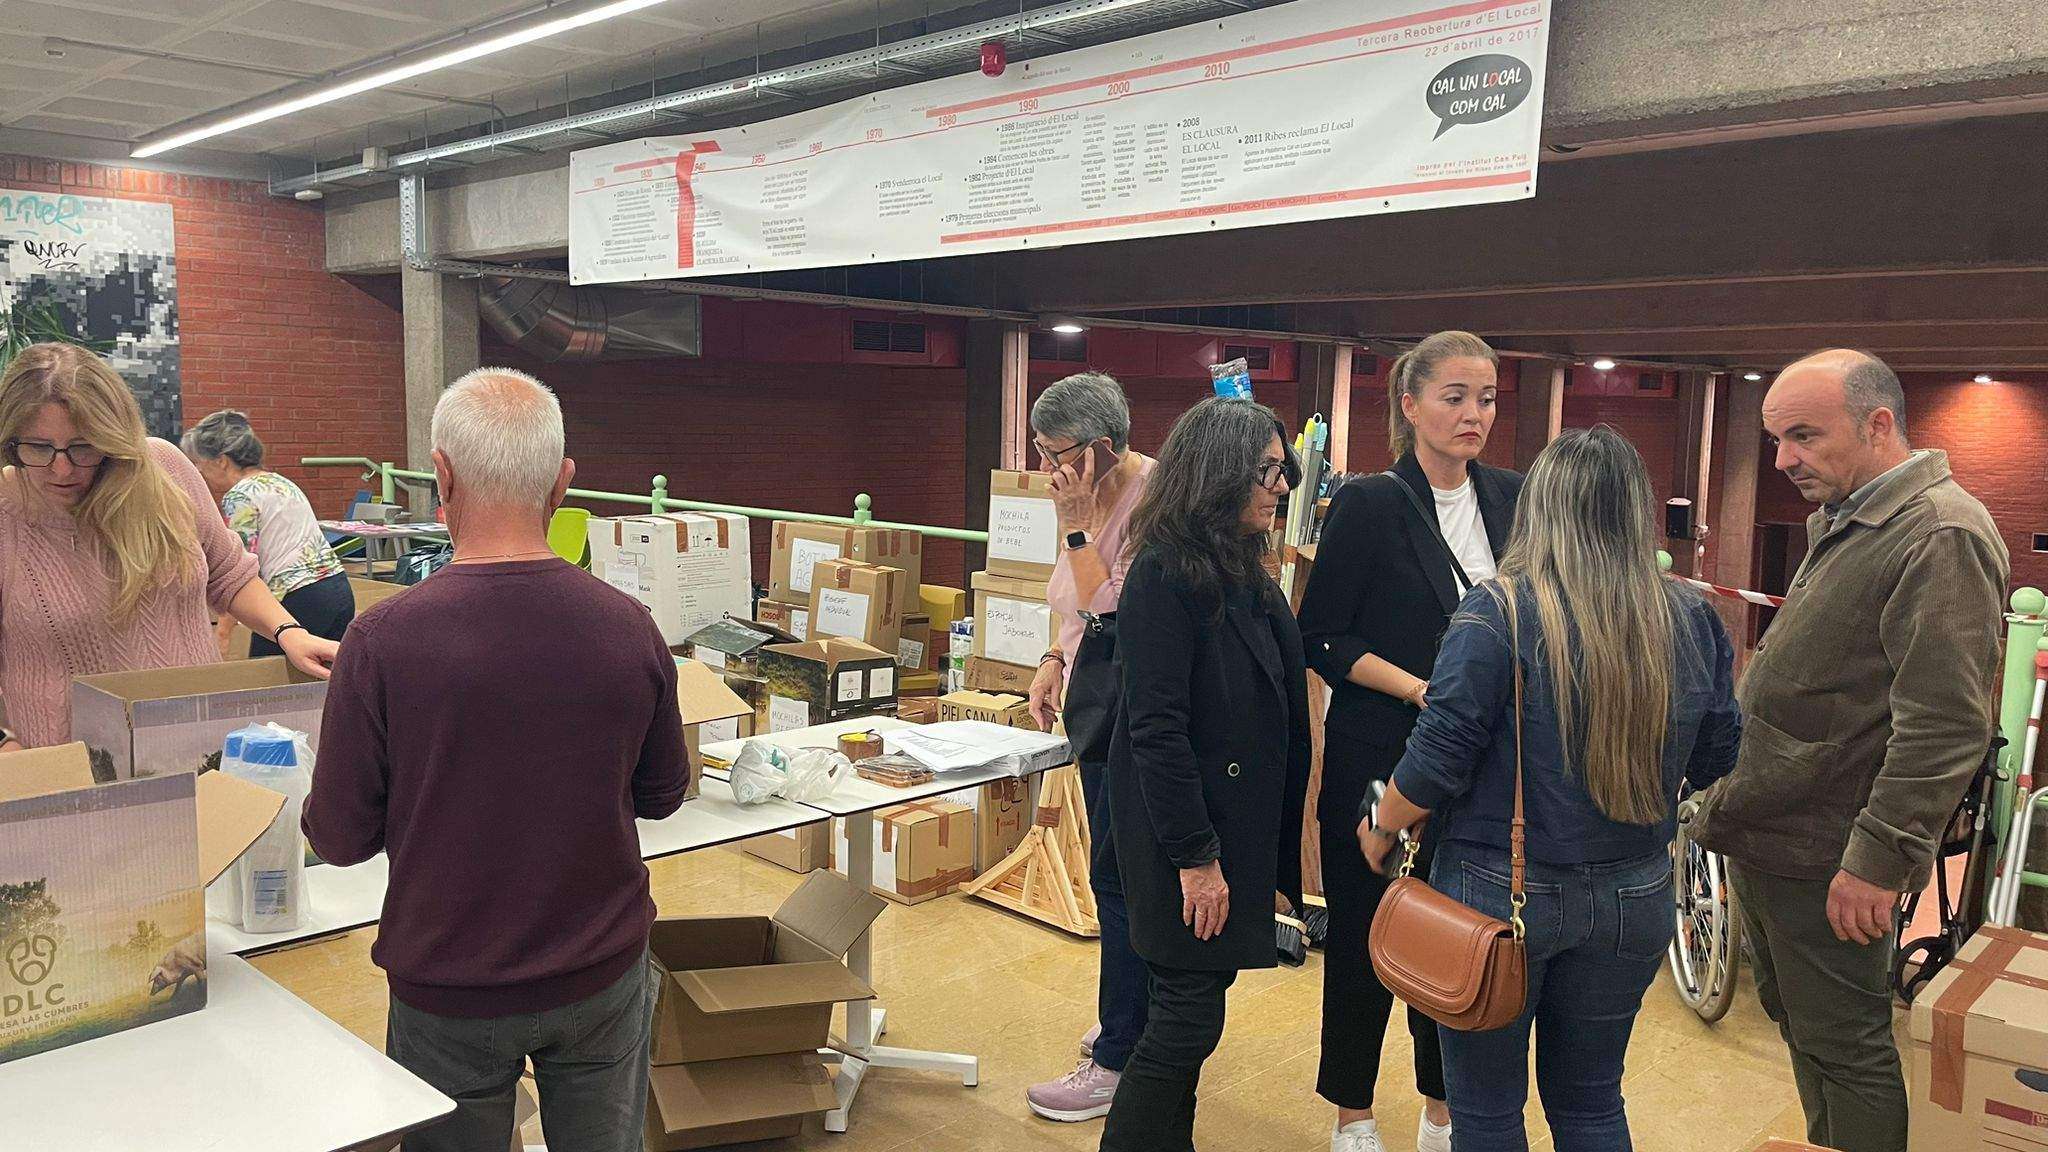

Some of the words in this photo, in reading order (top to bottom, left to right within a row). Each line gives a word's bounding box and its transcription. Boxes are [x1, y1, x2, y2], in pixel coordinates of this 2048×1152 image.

[1357, 33, 1399, 48] Tercera
[1404, 18, 1471, 39] Reobertura
[1475, 12, 1500, 24] d'El
[1505, 6, 1541, 20] Local
[1424, 48, 1438, 58] 22
[1443, 39, 1482, 53] d'abril
[1488, 36, 1502, 46] de
[1509, 28, 1540, 42] 2017
[1204, 62, 1230, 78] 2010
[1107, 81, 1130, 96] 2000
[1432, 79, 1456, 95] CAL
[1459, 74, 1479, 91] UN
[1482, 67, 1522, 88] LOCAL
[1019, 99, 1038, 112] 1990
[1450, 98, 1480, 116] COM
[1483, 94, 1507, 112] CAL
[938, 114, 956, 127] 1980
[1062, 111, 1079, 121] Local
[867, 128, 882, 140] 1970
[1183, 131, 1192, 141] ES
[1193, 125, 1238, 139] CLAUSURA
[1244, 133, 1262, 144] 2011
[1264, 131, 1287, 142] Ribes
[1288, 126, 1319, 139] reclama
[1320, 123, 1329, 133] El
[1331, 118, 1354, 131] Local
[1182, 145, 1192, 154] EL
[1194, 141, 1221, 152] LOCAL
[984, 155, 997, 164] 1984
[998, 152, 1028, 162] Comencen
[1029, 149, 1037, 157] les
[1018, 165, 1035, 175] Local
[983, 209, 1008, 219] eleccions
[1010, 204, 1041, 215] municipals
[1000, 509, 1029, 520] MOCHILA
[965, 708, 997, 724] SANA
[3, 983, 65, 1017] DLC
[0, 1019, 19, 1030] ESA
[22, 1013, 41, 1024] LAS
[44, 1001, 89, 1019] CUMBRES
[0, 1026, 31, 1039] UXURY
